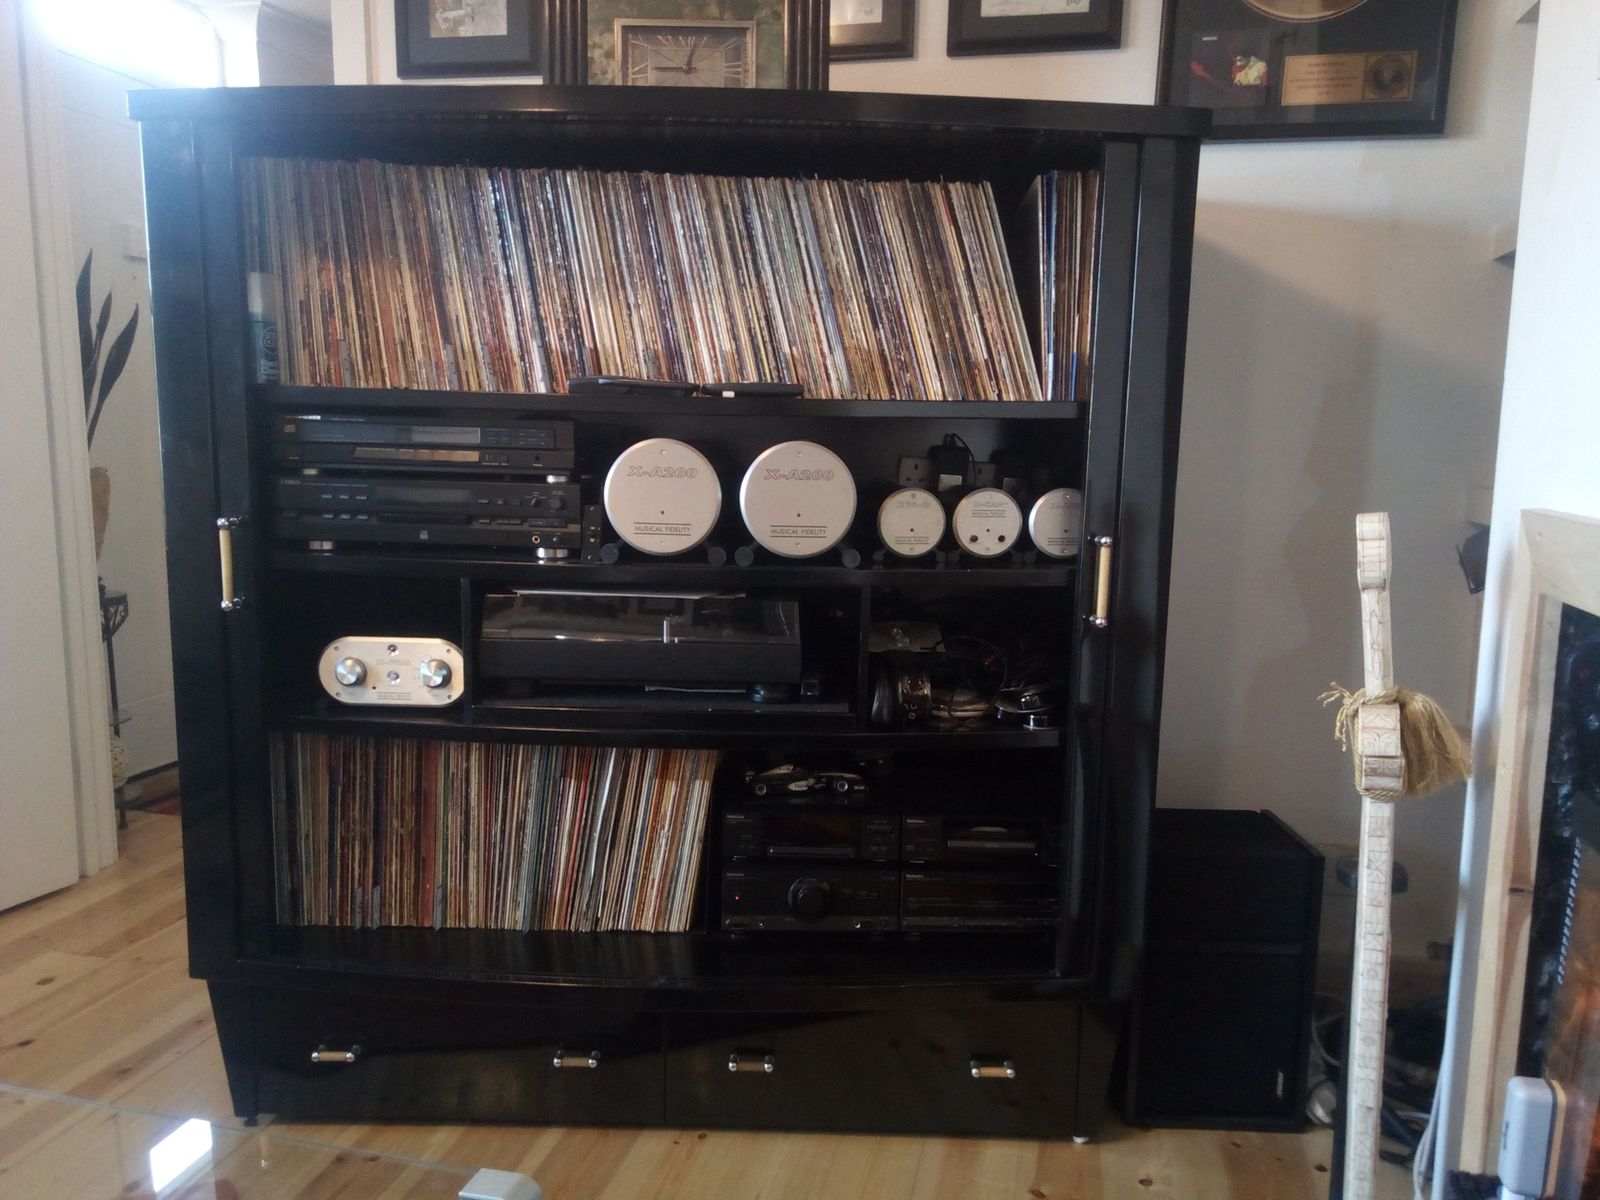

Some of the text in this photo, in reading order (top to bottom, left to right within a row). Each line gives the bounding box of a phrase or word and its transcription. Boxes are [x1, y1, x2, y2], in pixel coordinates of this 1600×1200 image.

[627, 466, 698, 479] X-A200
[763, 468, 834, 481] X-A200
[634, 525, 663, 533] MUSICAL
[801, 528, 827, 536] FIDELITY
